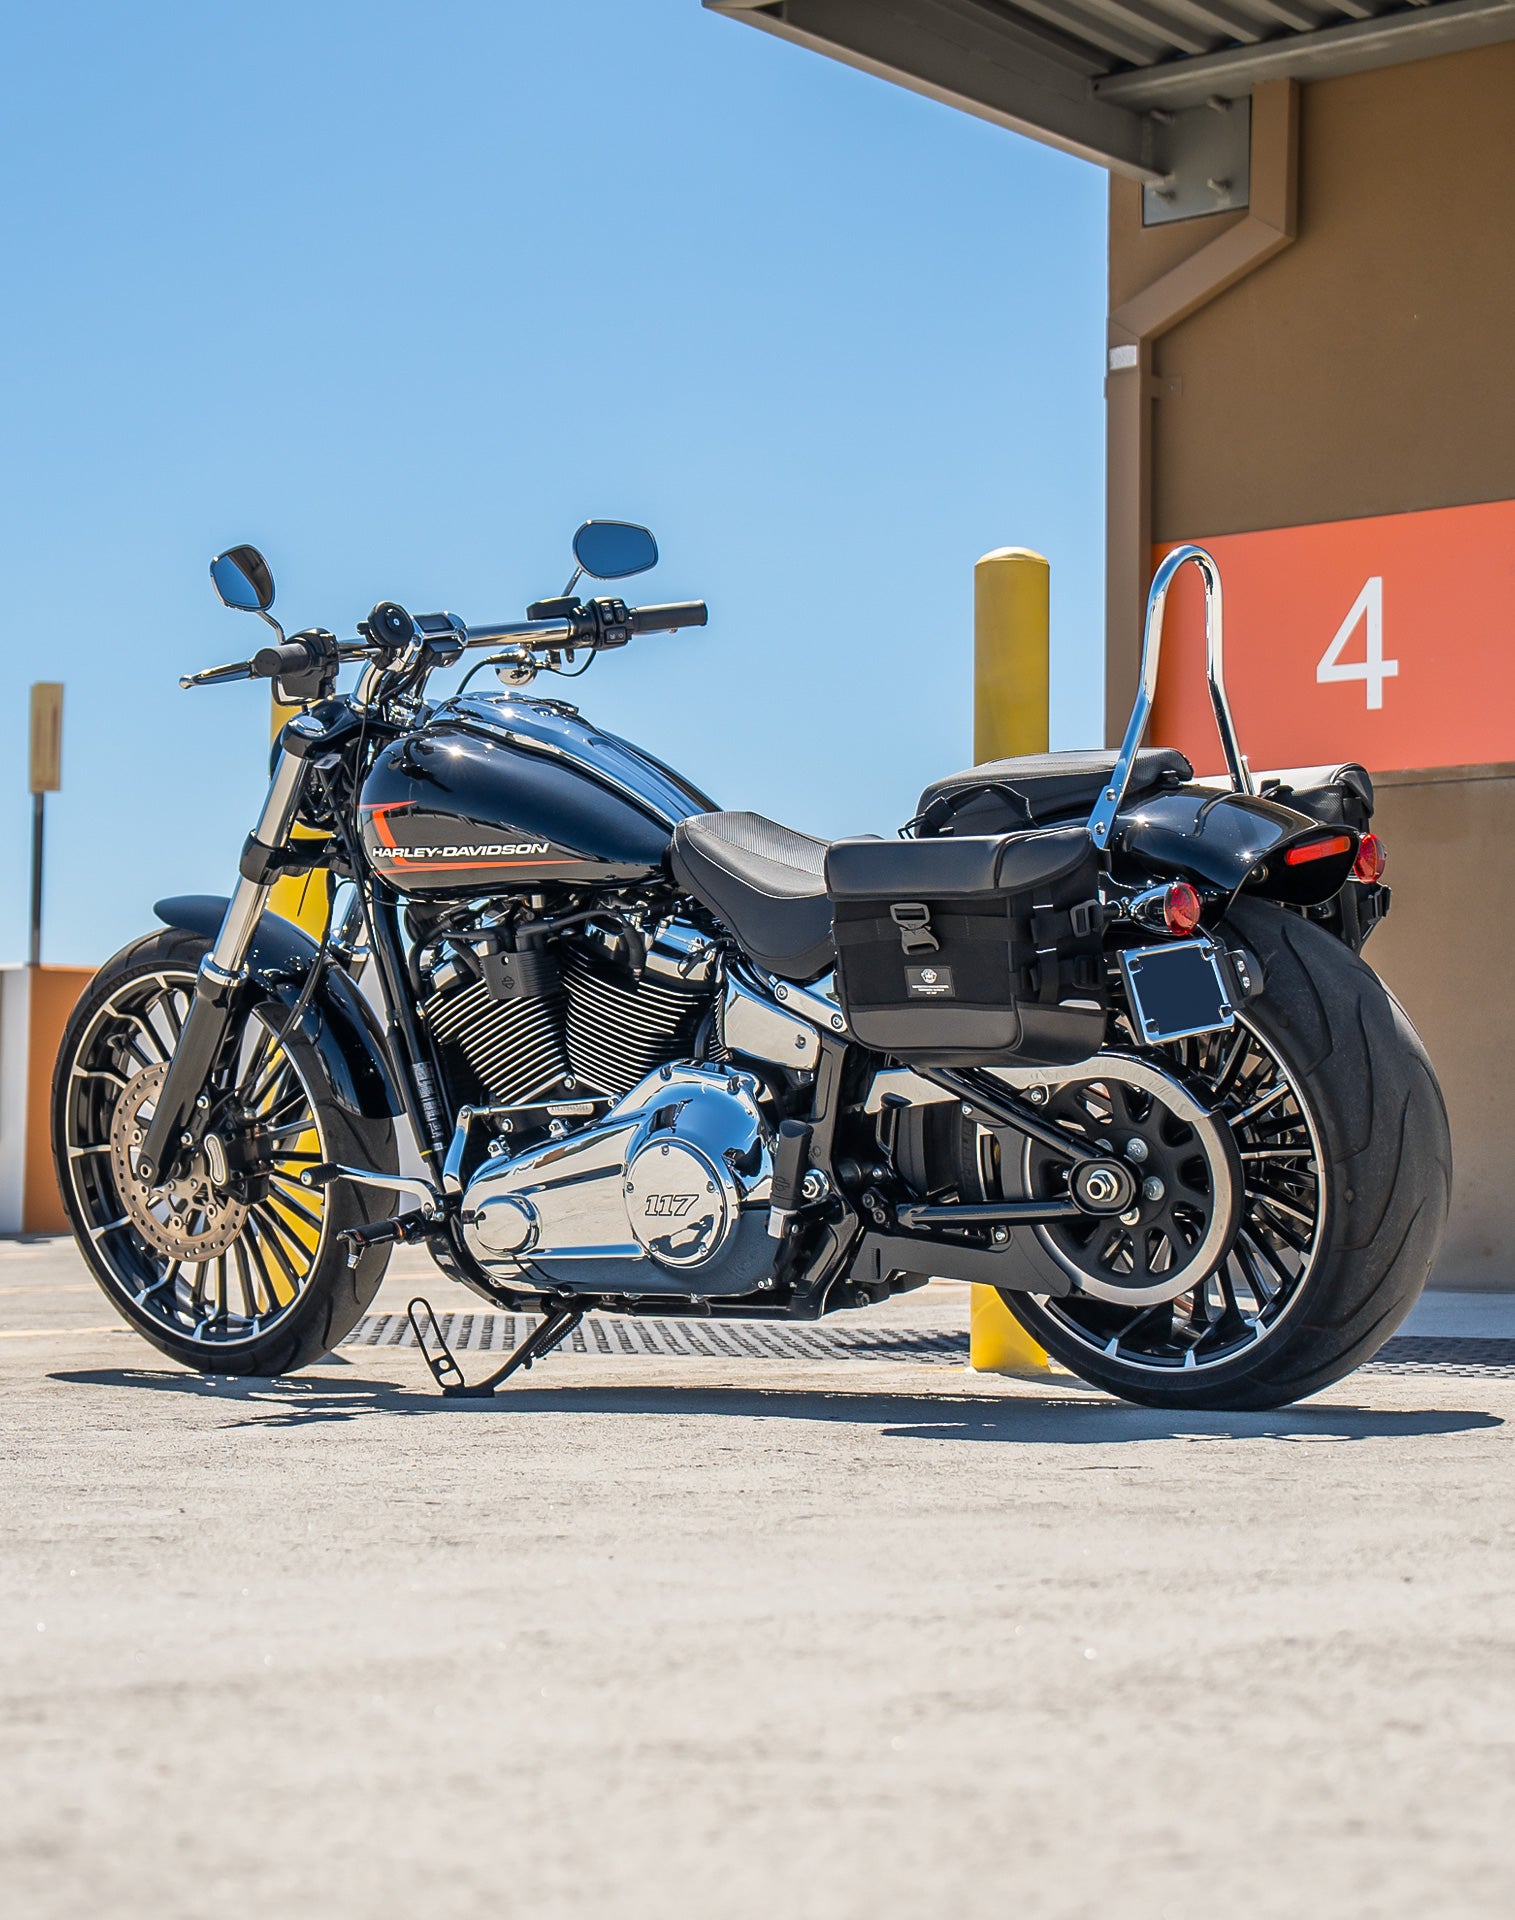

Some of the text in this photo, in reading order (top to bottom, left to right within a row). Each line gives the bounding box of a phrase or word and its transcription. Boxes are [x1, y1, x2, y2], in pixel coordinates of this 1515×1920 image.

[1316, 576, 1399, 710] 4
[372, 842, 550, 858] HARLEY-DAVIDSON
[645, 1194, 699, 1217] 117
